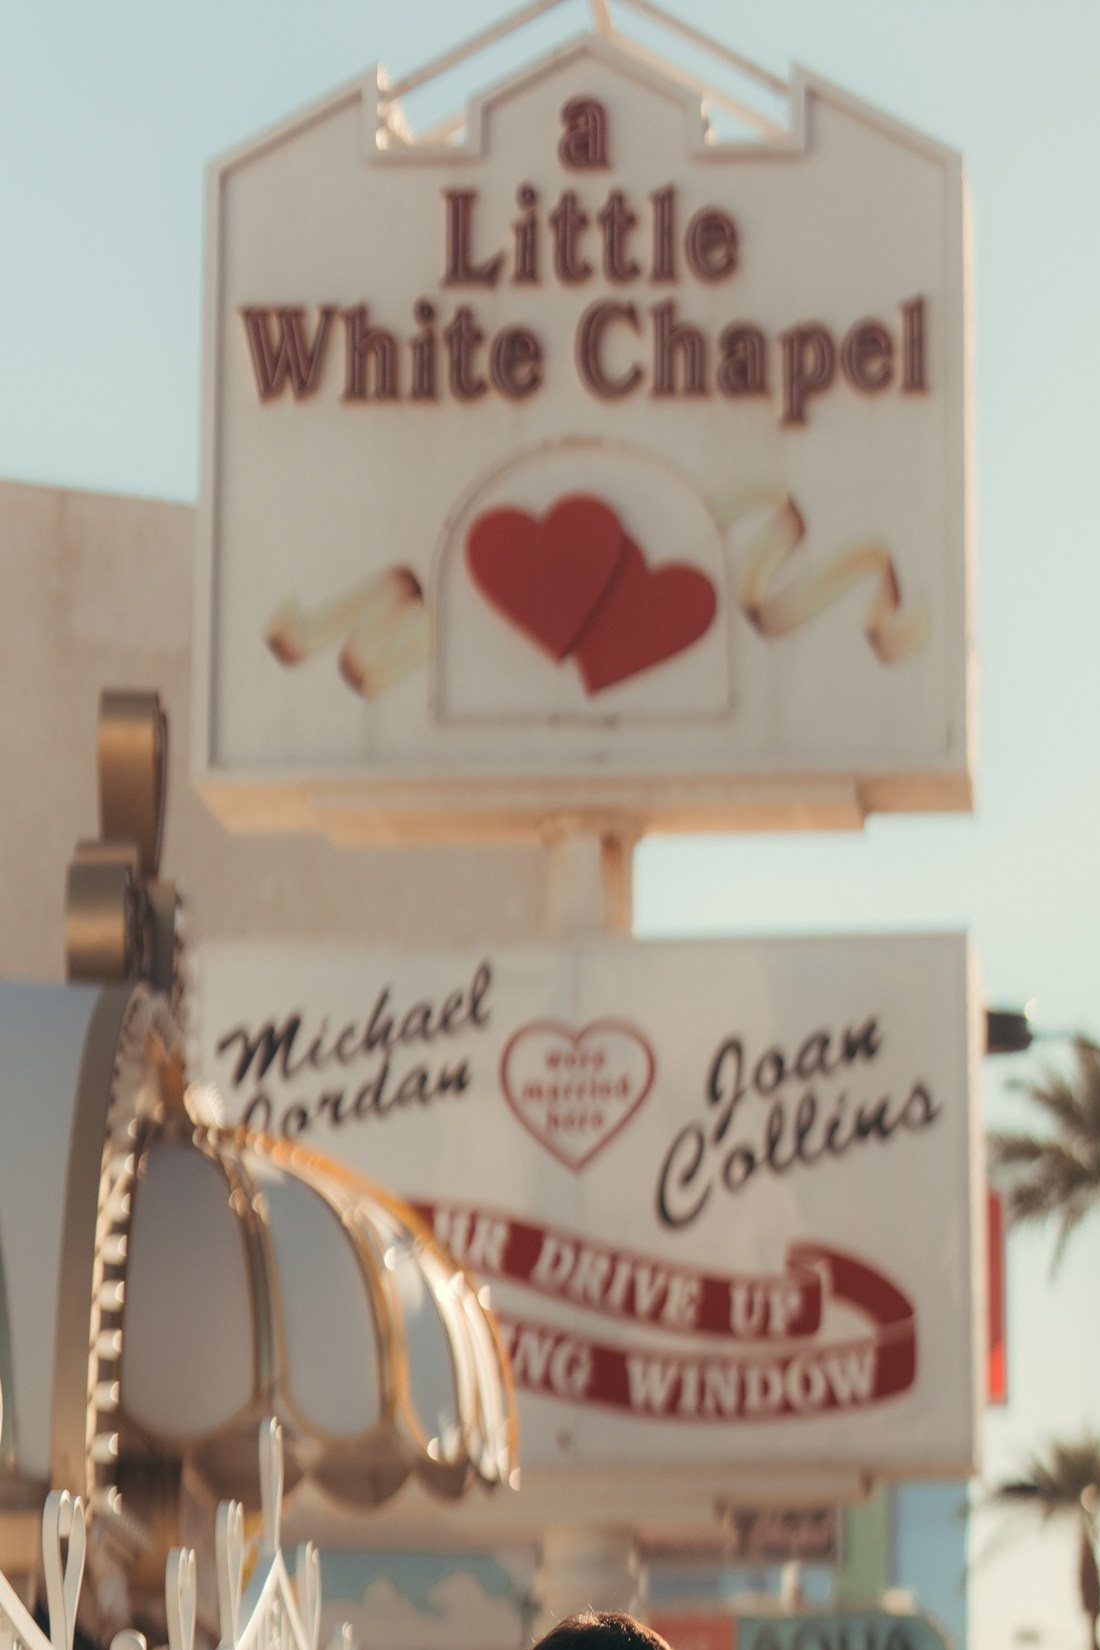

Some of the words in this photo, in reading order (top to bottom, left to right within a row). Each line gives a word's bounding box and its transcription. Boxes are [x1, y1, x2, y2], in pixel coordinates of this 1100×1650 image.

[557, 95, 611, 172] a
[442, 185, 740, 288] Little
[240, 299, 544, 402] White
[574, 294, 930, 427] Chapel
[215, 958, 493, 1088] Michael
[706, 1014, 884, 1146] Joan
[654, 1080, 942, 1232] Collins
[532, 1235, 699, 1326] DRIVE
[729, 1285, 800, 1337] UP
[626, 1349, 876, 1414] WINDOW
